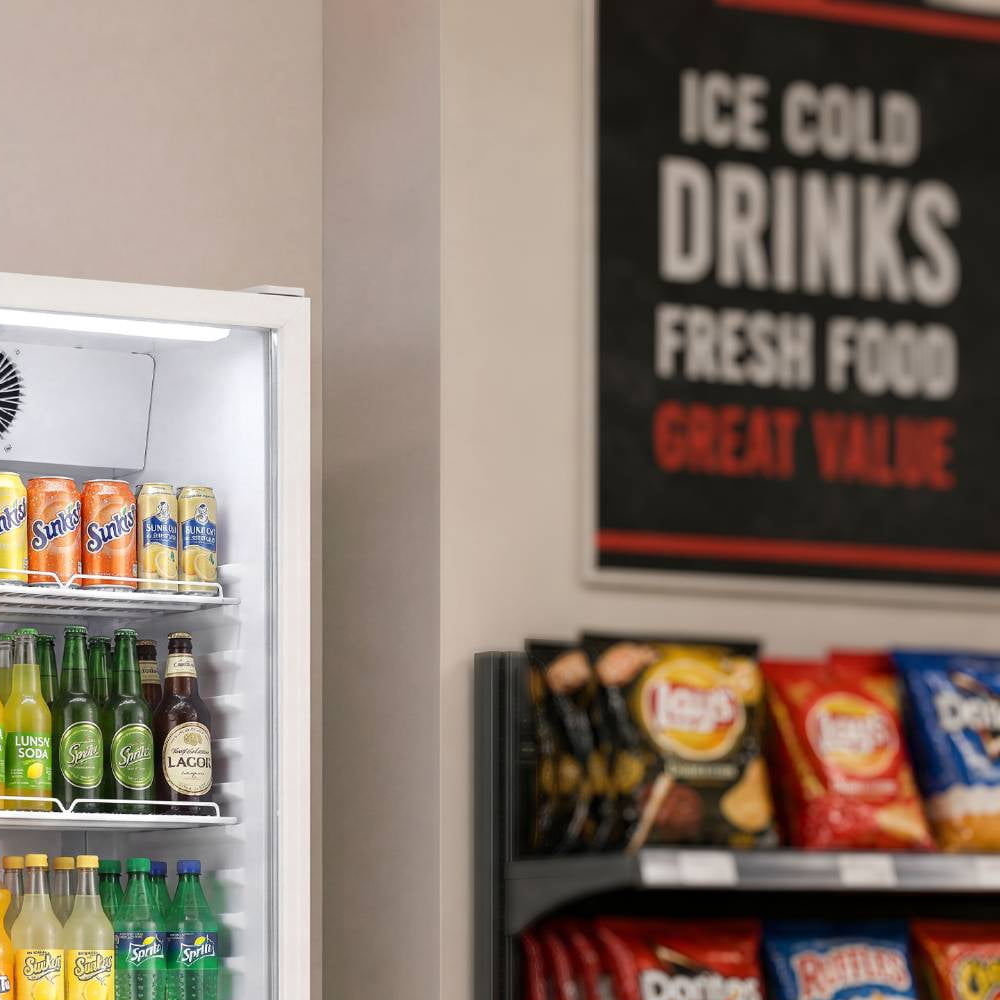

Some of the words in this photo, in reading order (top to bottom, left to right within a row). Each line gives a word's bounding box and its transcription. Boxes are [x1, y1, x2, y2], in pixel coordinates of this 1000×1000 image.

[679, 68, 770, 152] ICE
[781, 80, 922, 167] COLD
[657, 154, 962, 308] DRINKS
[654, 302, 816, 391] FRESH
[825, 316, 960, 400] FOOD
[652, 399, 800, 480] GREAT
[811, 409, 958, 491] VALUE
[18, 747, 48, 760] SODA
